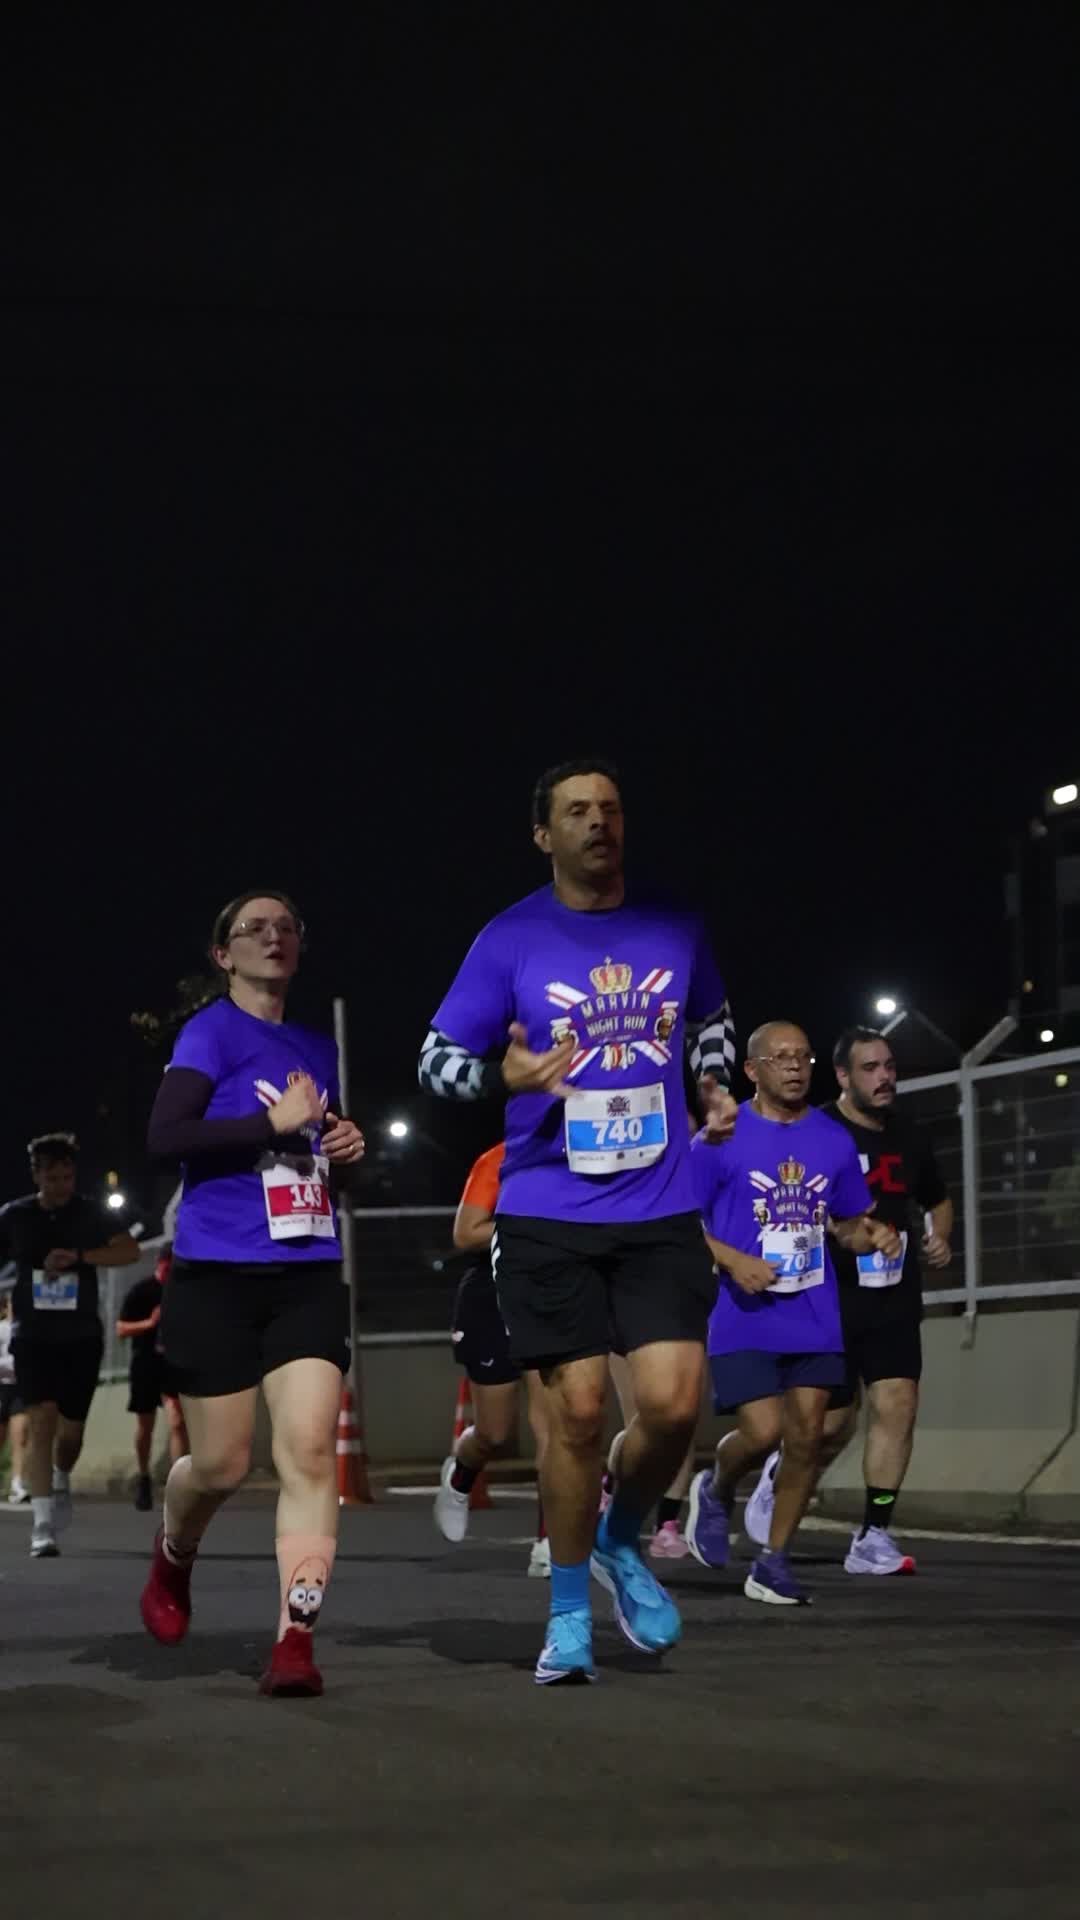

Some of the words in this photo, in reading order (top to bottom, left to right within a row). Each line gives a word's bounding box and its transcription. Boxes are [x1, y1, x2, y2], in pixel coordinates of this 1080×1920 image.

[581, 993, 650, 1018] MARVIN
[587, 1016, 619, 1037] NIGHT
[624, 1015, 648, 1031] RUN
[591, 1118, 643, 1145] 740
